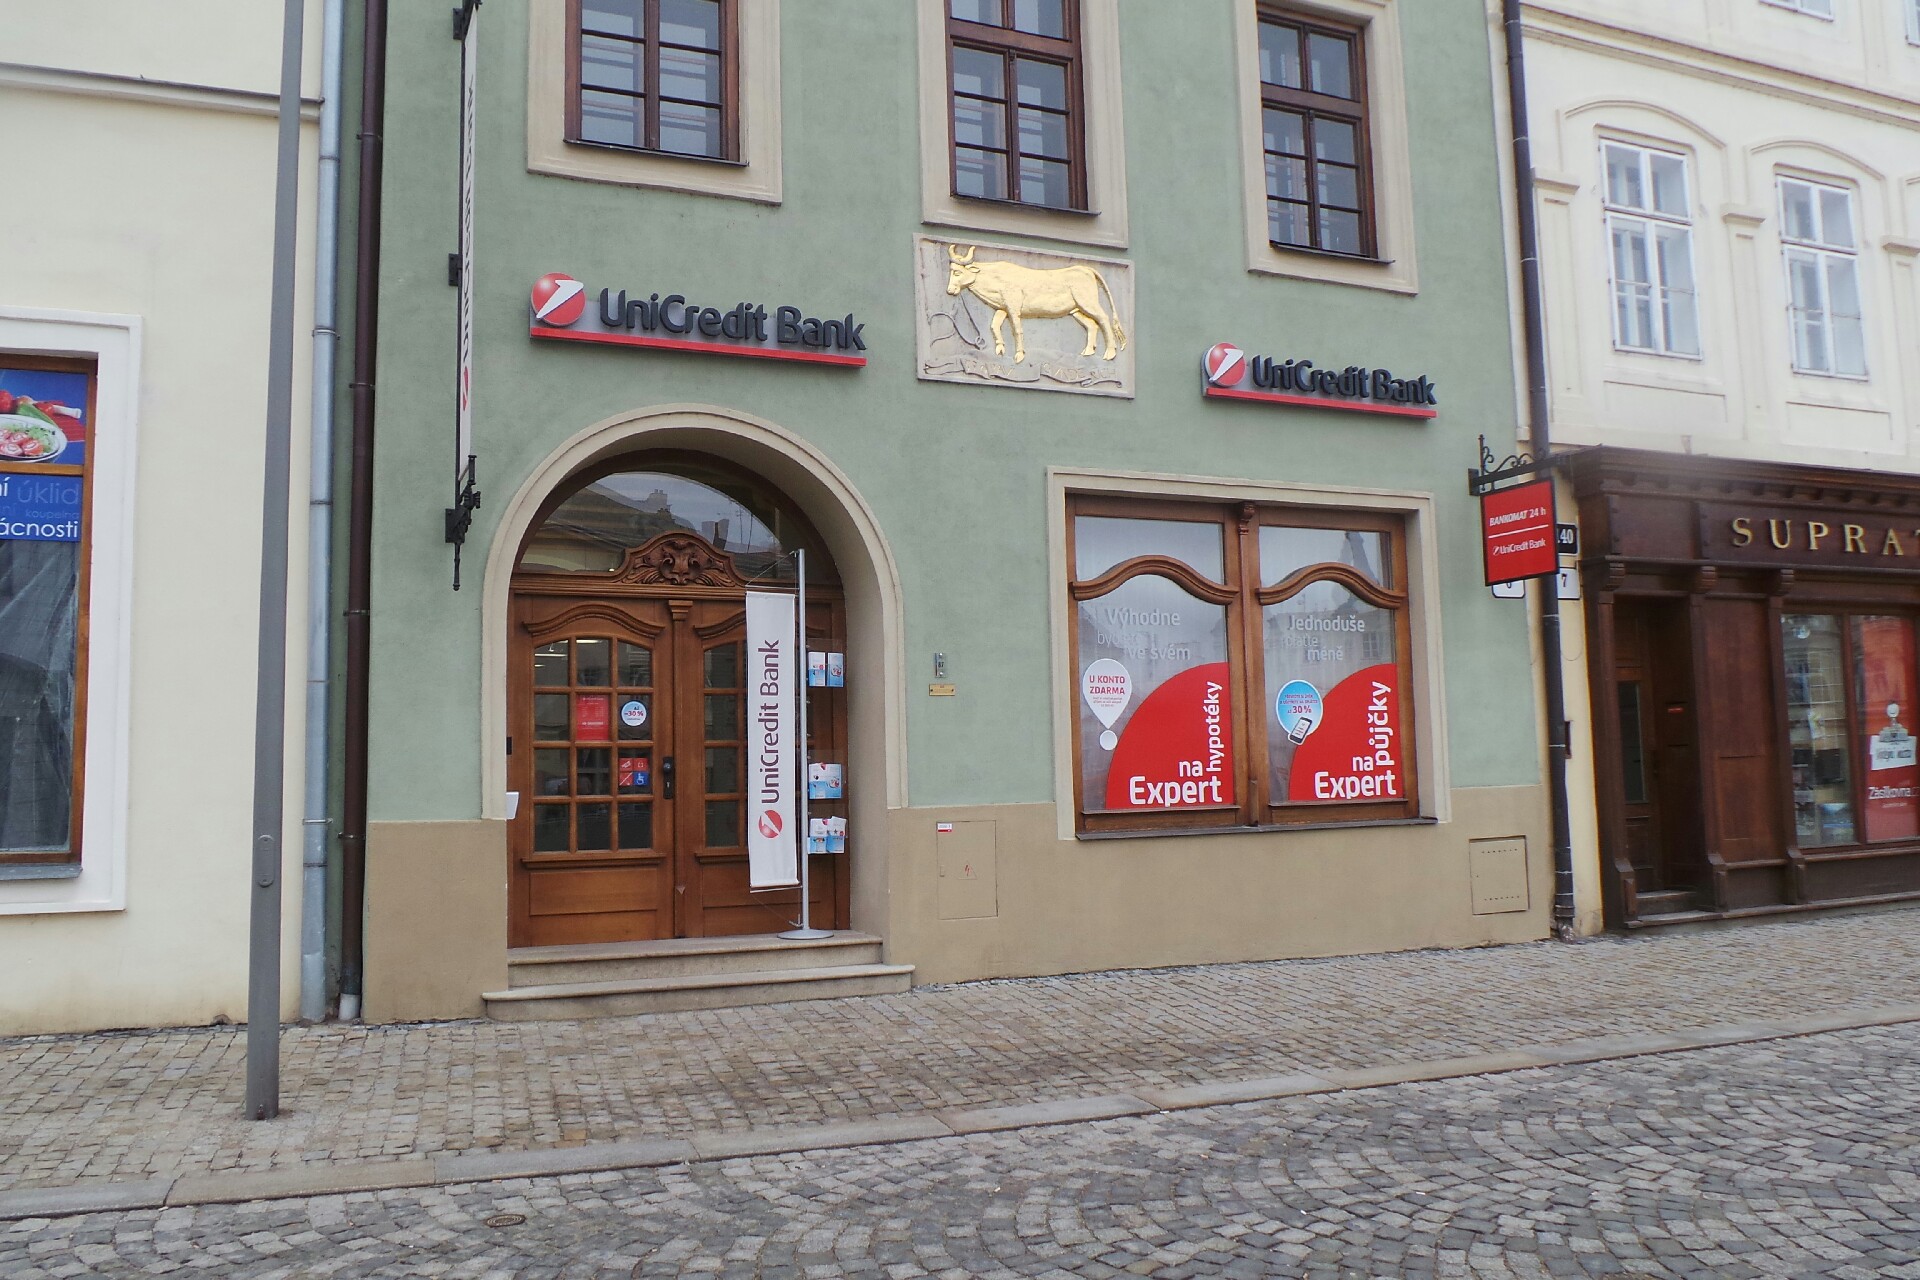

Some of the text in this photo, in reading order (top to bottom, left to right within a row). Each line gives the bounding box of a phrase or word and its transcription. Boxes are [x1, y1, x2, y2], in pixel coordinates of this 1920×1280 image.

[600, 287, 867, 351] UniCredit Bank
[1252, 355, 1437, 405] UniCredit Bank
[17, 480, 80, 504] úklid
[1489, 506, 1547, 526] BANKOMAT 24 h
[1500, 538, 1546, 555] UniCredit Bank
[1732, 517, 1920, 556] SUPRA
[1289, 614, 1365, 632] Jednoduše
[1306, 646, 1344, 661] méně
[1089, 675, 1126, 684] U KONTO
[1089, 686, 1126, 694] ZDARMA
[1292, 705, 1303, 714] 30
[757, 639, 780, 804] UniCredit Bank
[1203, 681, 1225, 772] hypotéky
[1367, 681, 1395, 766] půjčky
[1179, 760, 1203, 777] na
[1352, 756, 1374, 772] na
[1129, 775, 1223, 807] Expert
[1314, 769, 1397, 800] Expert
